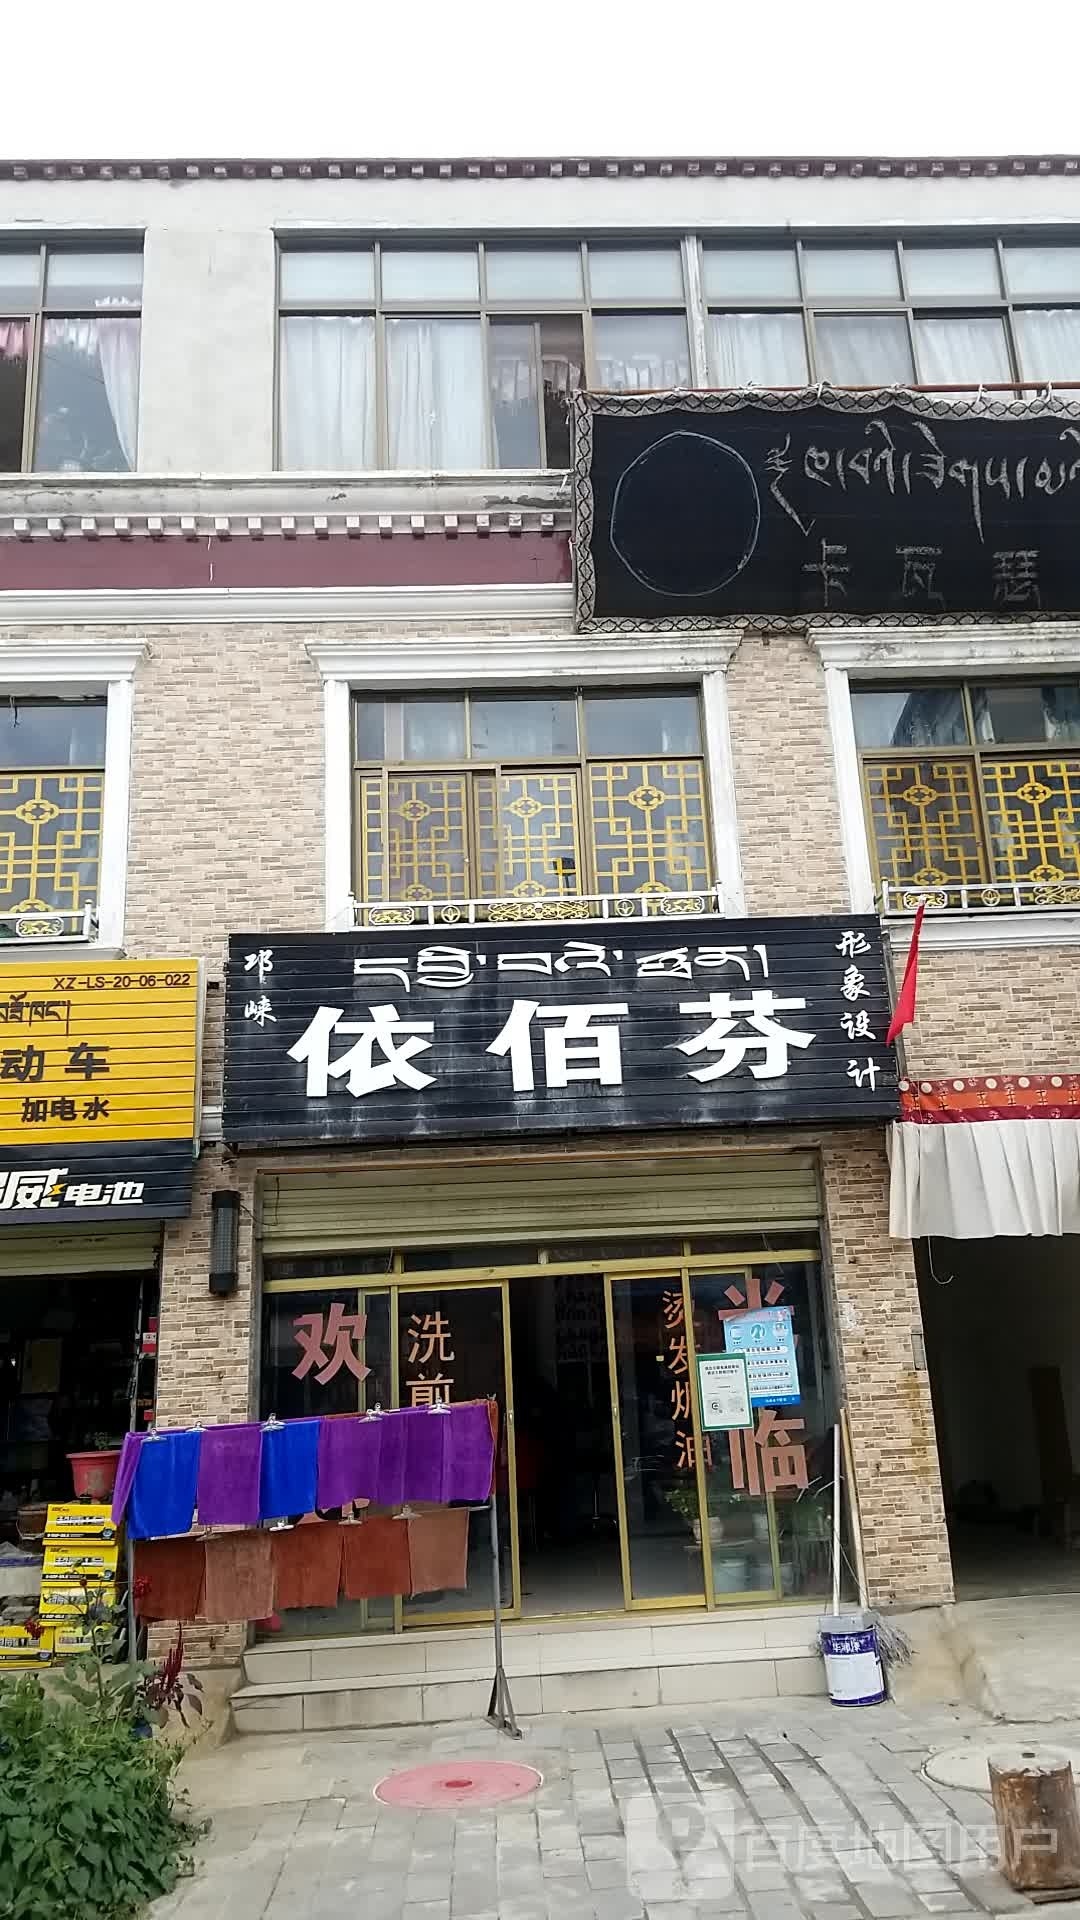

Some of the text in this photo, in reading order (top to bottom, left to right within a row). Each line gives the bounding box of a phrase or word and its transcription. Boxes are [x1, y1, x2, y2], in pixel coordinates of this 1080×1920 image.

[54, 973, 191, 990] XZ-LS-20-06-022
[244, 949, 277, 1027] 邛崃
[835, 930, 880, 1092] 形象设计
[0, 1042, 110, 1081] 动车
[287, 991, 815, 1098] 依佰芬
[21, 1097, 110, 1122] 加电水
[0, 1168, 145, 1210] 威电池
